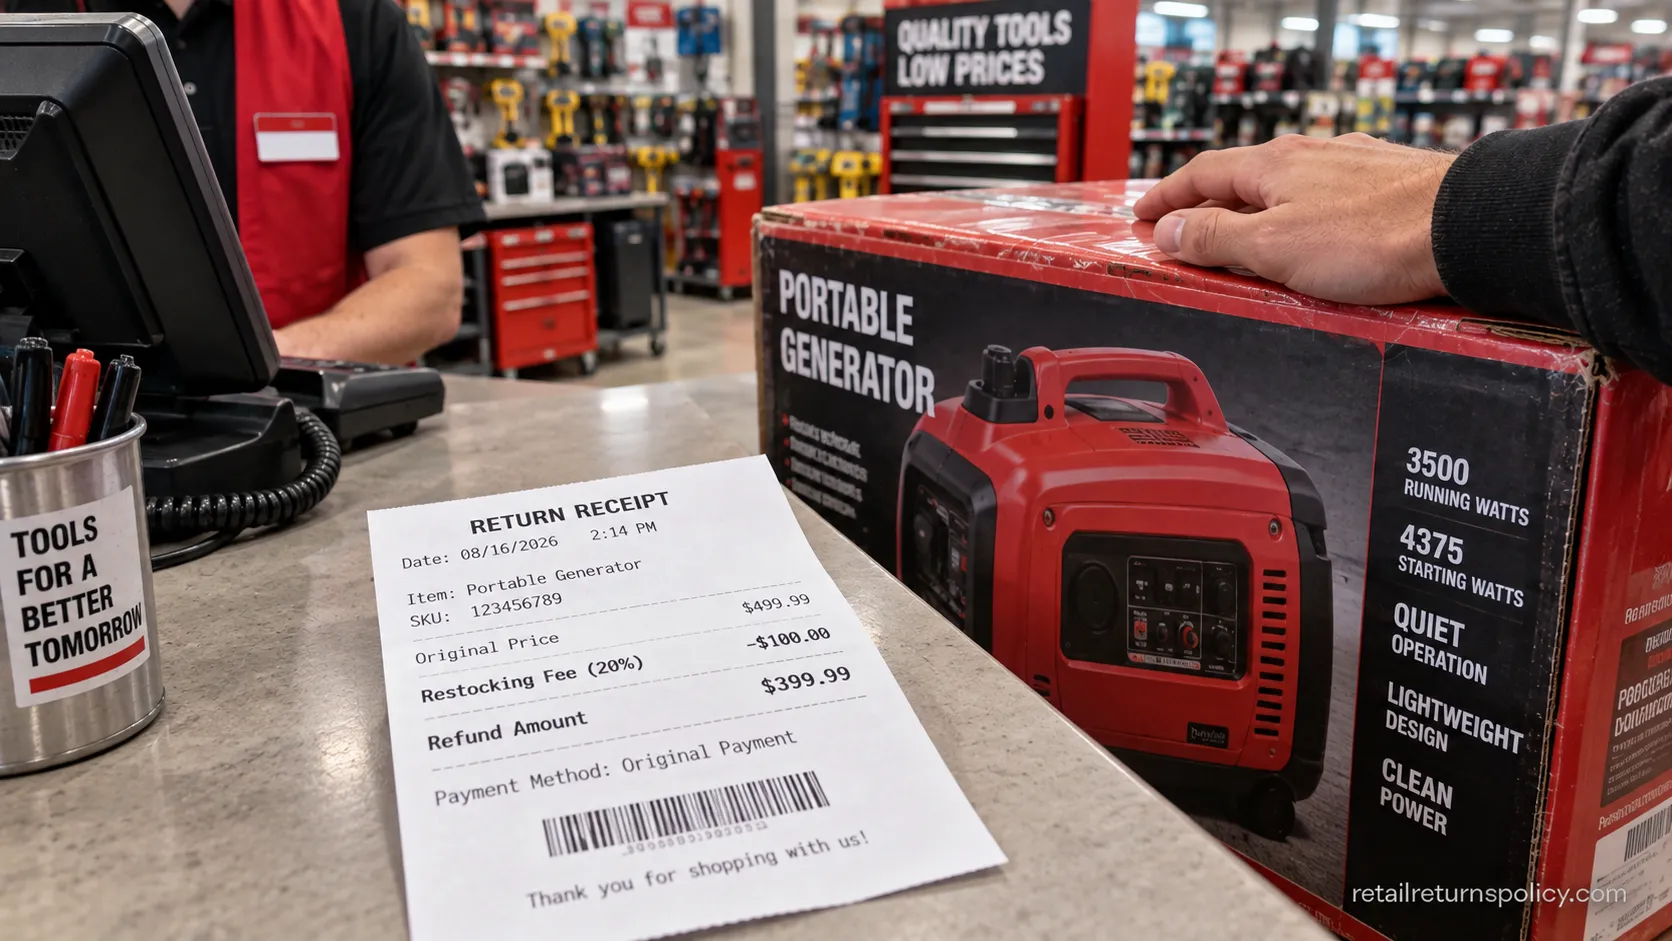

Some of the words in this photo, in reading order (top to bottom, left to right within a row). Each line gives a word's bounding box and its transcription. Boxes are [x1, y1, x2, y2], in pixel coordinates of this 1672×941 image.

[897, 15, 990, 54] QUALITY
[993, 9, 1072, 48] TOOLS
[897, 53, 950, 87] LOW
[954, 48, 1045, 86] PRICES
[779, 269, 914, 347] PORTABLE
[780, 327, 936, 418] GENERATOR
[1406, 447, 1470, 486] 3500
[470, 506, 566, 535] RETURN
[574, 491, 669, 519] RECEIPT
[1404, 478, 1470, 511] RUNNING
[1476, 496, 1529, 526] WATTS
[10, 515, 98, 558] TOOLS
[402, 553, 450, 570] Date:
[460, 535, 559, 561] 08/16/2026
[590, 524, 629, 542] 2:14
[636, 521, 657, 535] PM
[1400, 524, 1464, 565] 4375
[17, 560, 73, 596] FOR
[82, 553, 98, 581] A
[408, 588, 455, 606] Item:
[466, 572, 547, 596] Portable
[555, 559, 642, 582] Generator
[1398, 555, 1467, 591] STARTING
[1471, 576, 1524, 608] WATTS
[21, 584, 114, 633] BETTER
[410, 611, 451, 628] SKU:
[471, 592, 563, 619] 123456789
[415, 641, 499, 667] Original
[508, 632, 560, 651] Price
[742, 593, 811, 615] $499.99
[1394, 602, 1465, 648] QUIET
[24, 602, 143, 667] TOMORROW
[421, 673, 535, 703] Restocking
[543, 666, 578, 684] Fee
[587, 655, 644, 679] (20%)
[746, 626, 831, 650] -$100.00
[1392, 634, 1488, 686] OPERATION
[427, 724, 502, 751] Refund
[513, 711, 588, 737] Amount
[761, 665, 851, 696] $399.99
[1385, 709, 1449, 753] DESIGN
[1388, 681, 1524, 754] LIGHTWEIGHT
[435, 778, 520, 807] Payment
[530, 763, 611, 790] Method:
[622, 744, 711, 773] Original
[719, 730, 798, 756] Payment
[1382, 758, 1453, 810] CLEAN
[1380, 786, 1448, 836] POWER
[526, 884, 588, 909] Thank
[598, 878, 635, 900] you
[644, 868, 677, 888] for
[689, 849, 778, 880] shopping
[785, 838, 831, 860] with
[838, 830, 870, 850] us!
